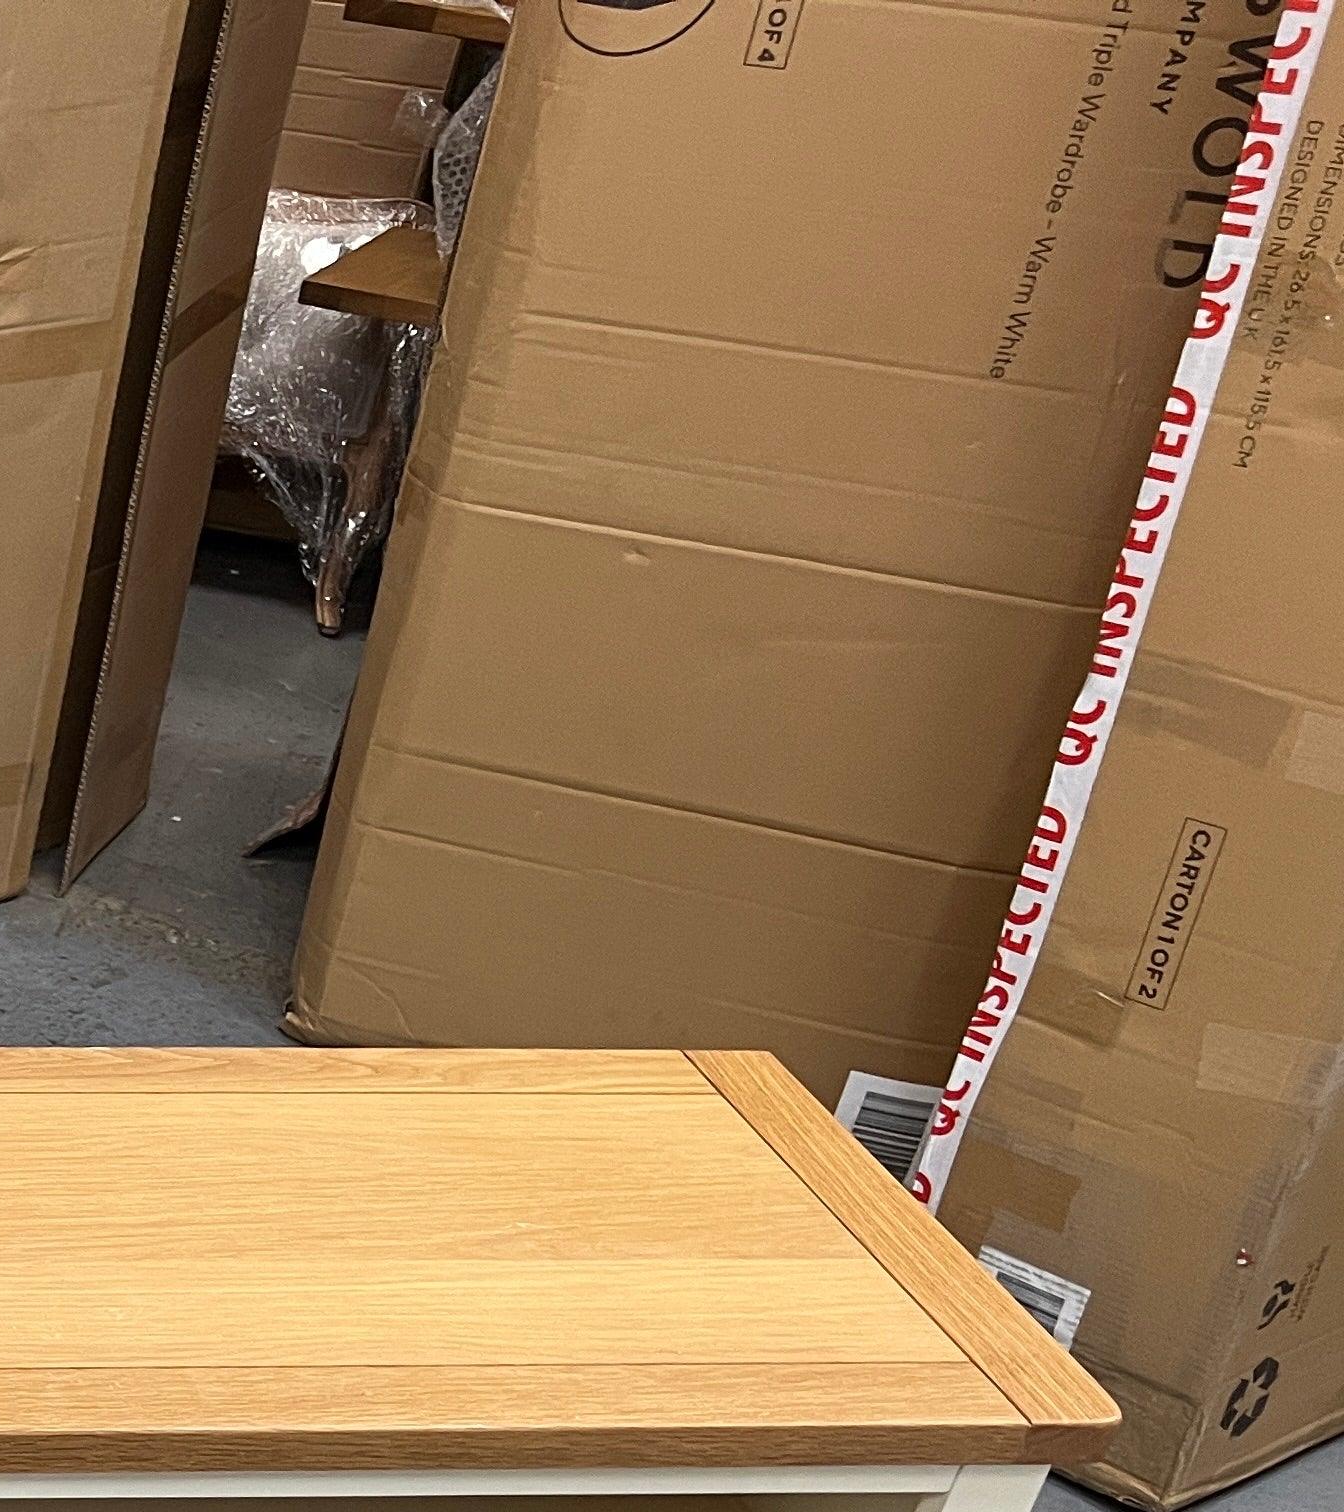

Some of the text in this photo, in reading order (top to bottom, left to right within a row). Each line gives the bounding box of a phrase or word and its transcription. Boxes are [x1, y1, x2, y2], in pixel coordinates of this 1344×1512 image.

[764, 8, 788, 44] OF
[1087, 20, 1130, 87] Triple
[1045, 93, 1107, 214] Wardrobe
[1277, 120, 1325, 231] DESIGNED
[1012, 236, 1057, 305] Warm
[1267, 236, 1288, 258] IN
[989, 311, 1032, 379] White
[1231, 435, 1256, 469] CM
[1161, 829, 1212, 932] CARTON
[1138, 983, 1158, 999] 2
[1146, 948, 1170, 984] OF
